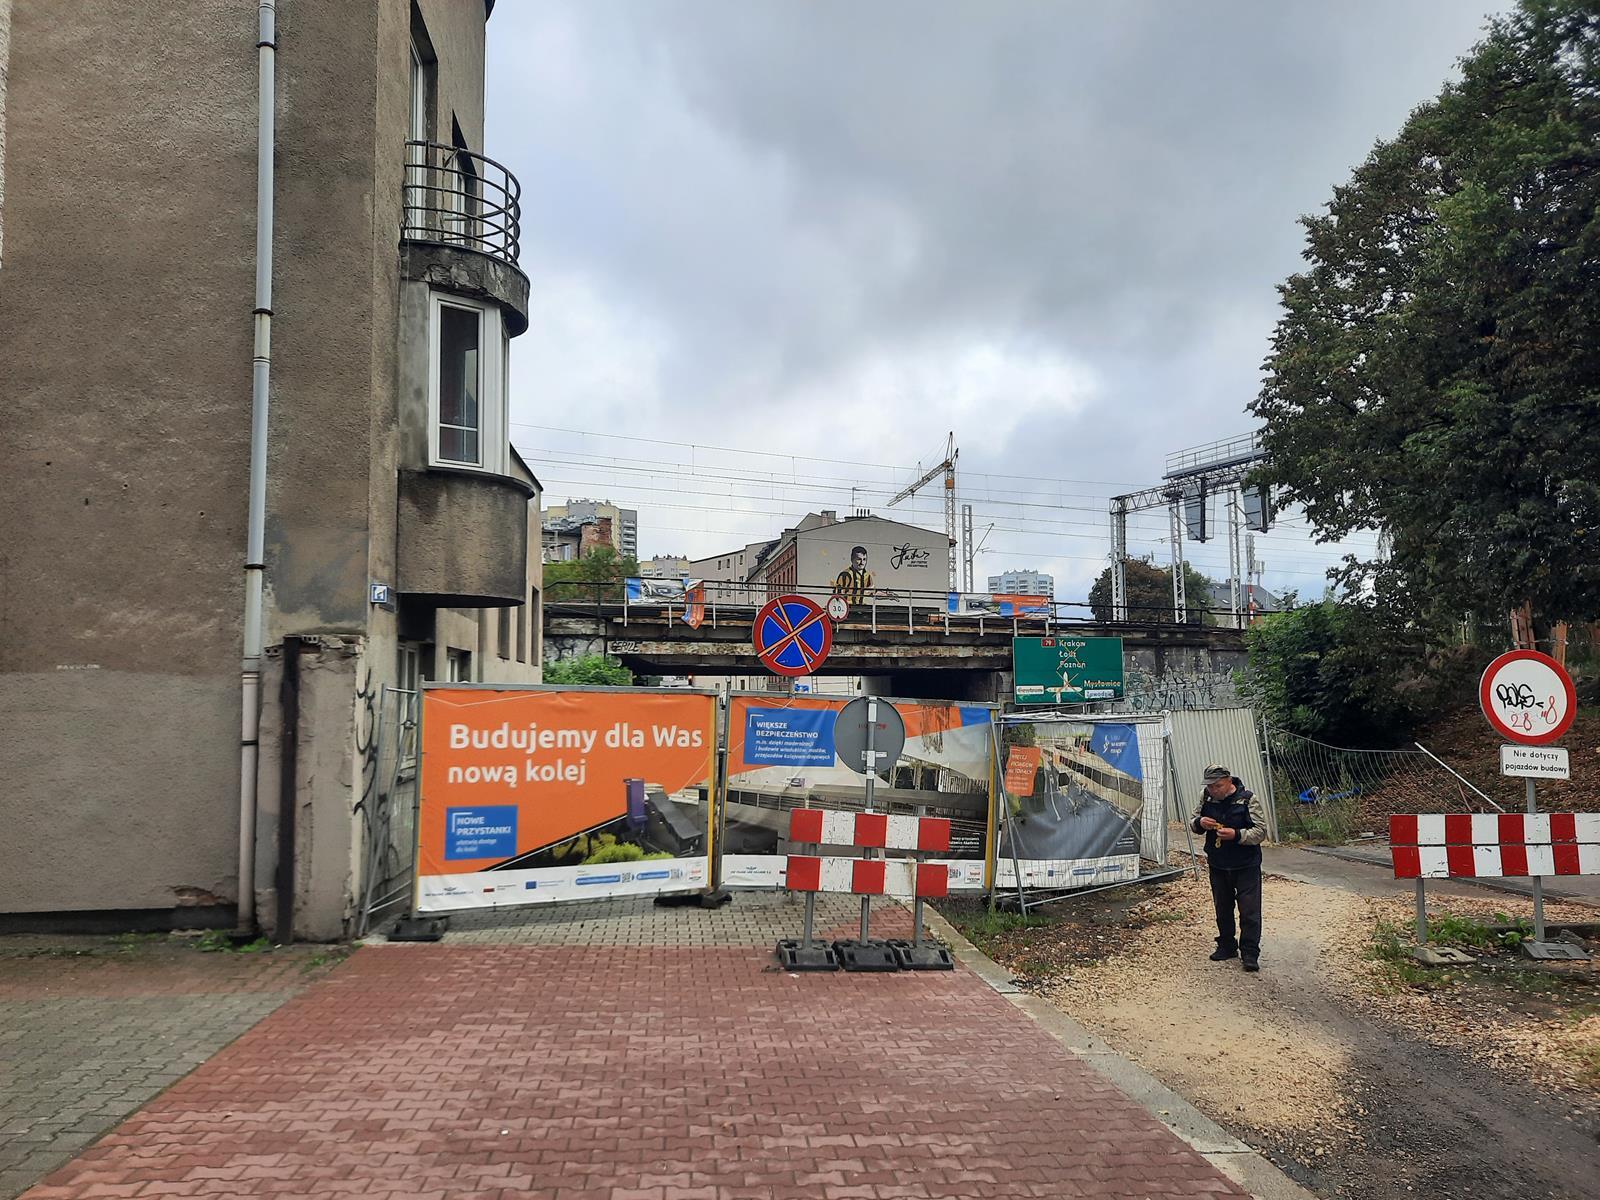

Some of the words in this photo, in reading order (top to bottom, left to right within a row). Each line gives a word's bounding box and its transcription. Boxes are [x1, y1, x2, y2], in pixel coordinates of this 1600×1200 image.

[756, 721, 788, 729] WIĘKSZE
[450, 722, 597, 753] Budujemy
[604, 722, 645, 748] dla
[652, 725, 703, 748] Was
[755, 730, 819, 739] BEZPIECZEŃSTWO
[1513, 750, 1527, 758] Nie
[1529, 751, 1559, 761] dotyczy
[448, 764, 517, 788] nową
[525, 759, 586, 785] kolej
[1505, 763, 1538, 772] pojazdów
[1540, 763, 1567, 774] budowy
[457, 816, 485, 825] NOWE
[456, 826, 512, 836] PRZYSTANKI
